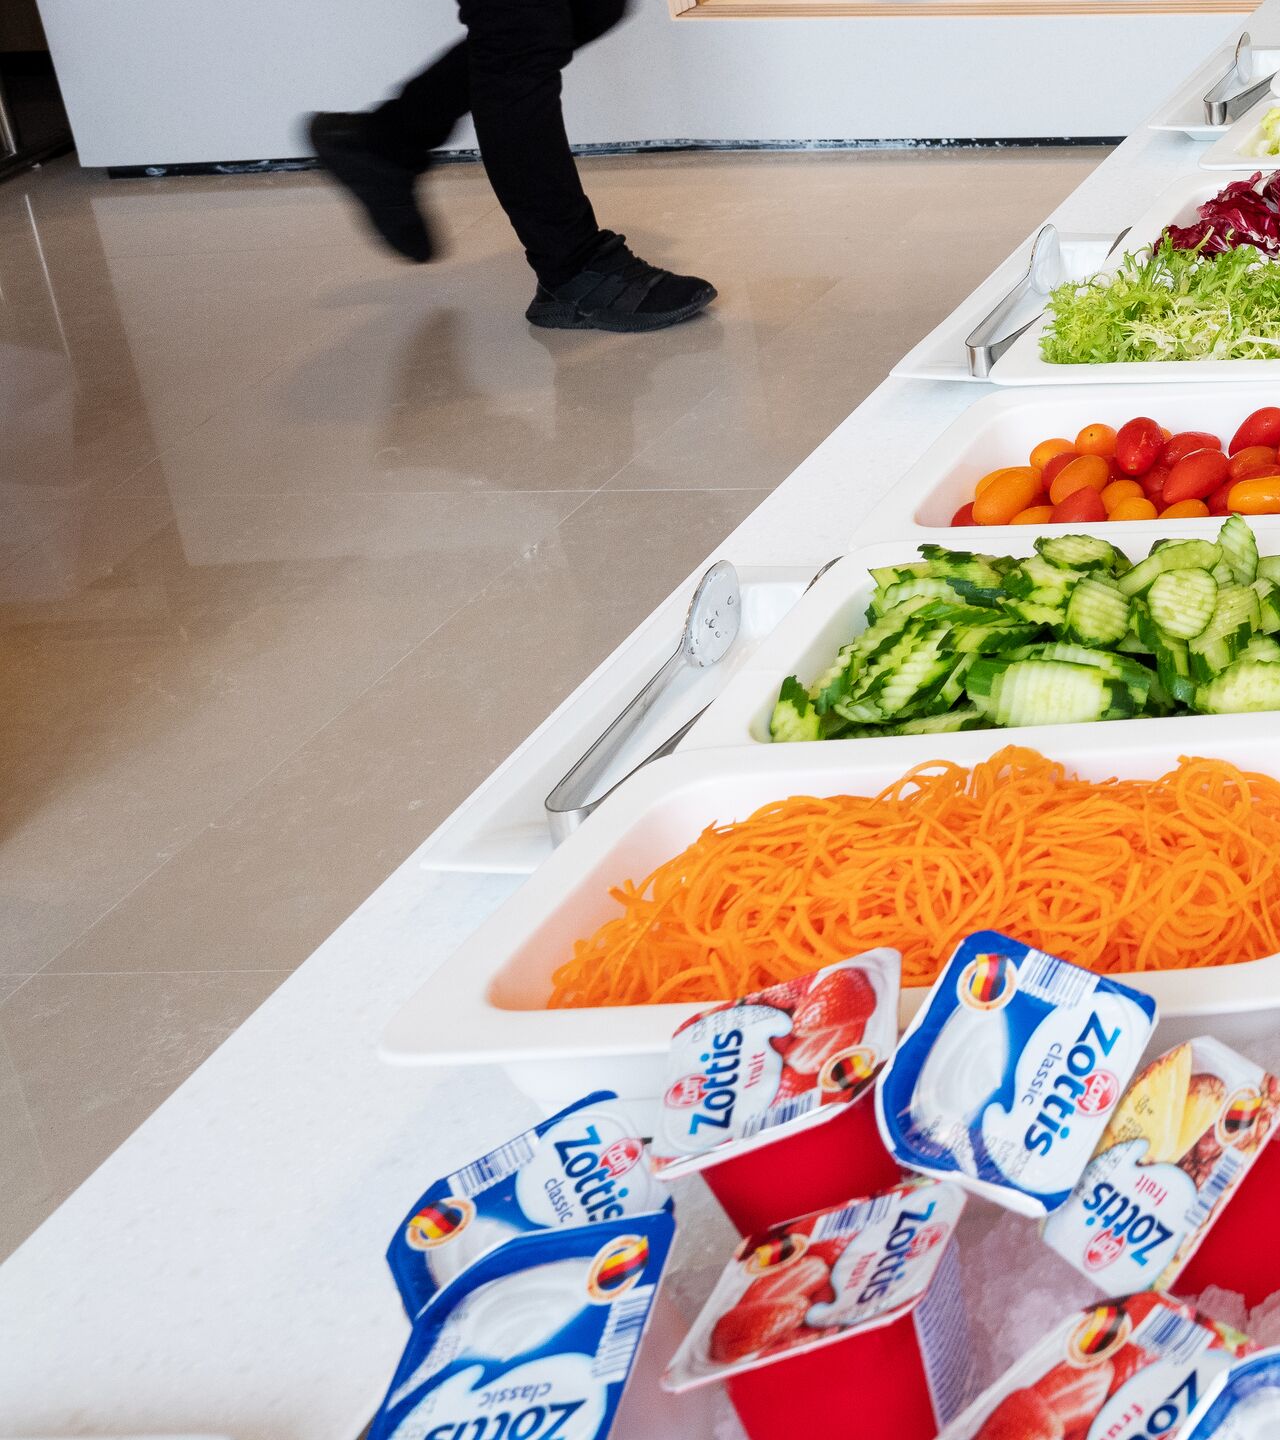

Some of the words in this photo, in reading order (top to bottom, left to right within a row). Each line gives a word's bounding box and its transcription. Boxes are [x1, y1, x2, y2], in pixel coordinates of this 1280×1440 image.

[688, 1028, 743, 1135] Zottis
[744, 1051, 766, 1089] fruit
[1022, 1043, 1062, 1105] classic
[1024, 1011, 1121, 1156] Zottis
[543, 1178, 574, 1222] classic
[554, 1124, 629, 1222] Zottis
[1136, 1174, 1168, 1206] fruit
[857, 1201, 936, 1304] Zottis
[1083, 1182, 1174, 1266] Zottis
[478, 1382, 552, 1408] classic
